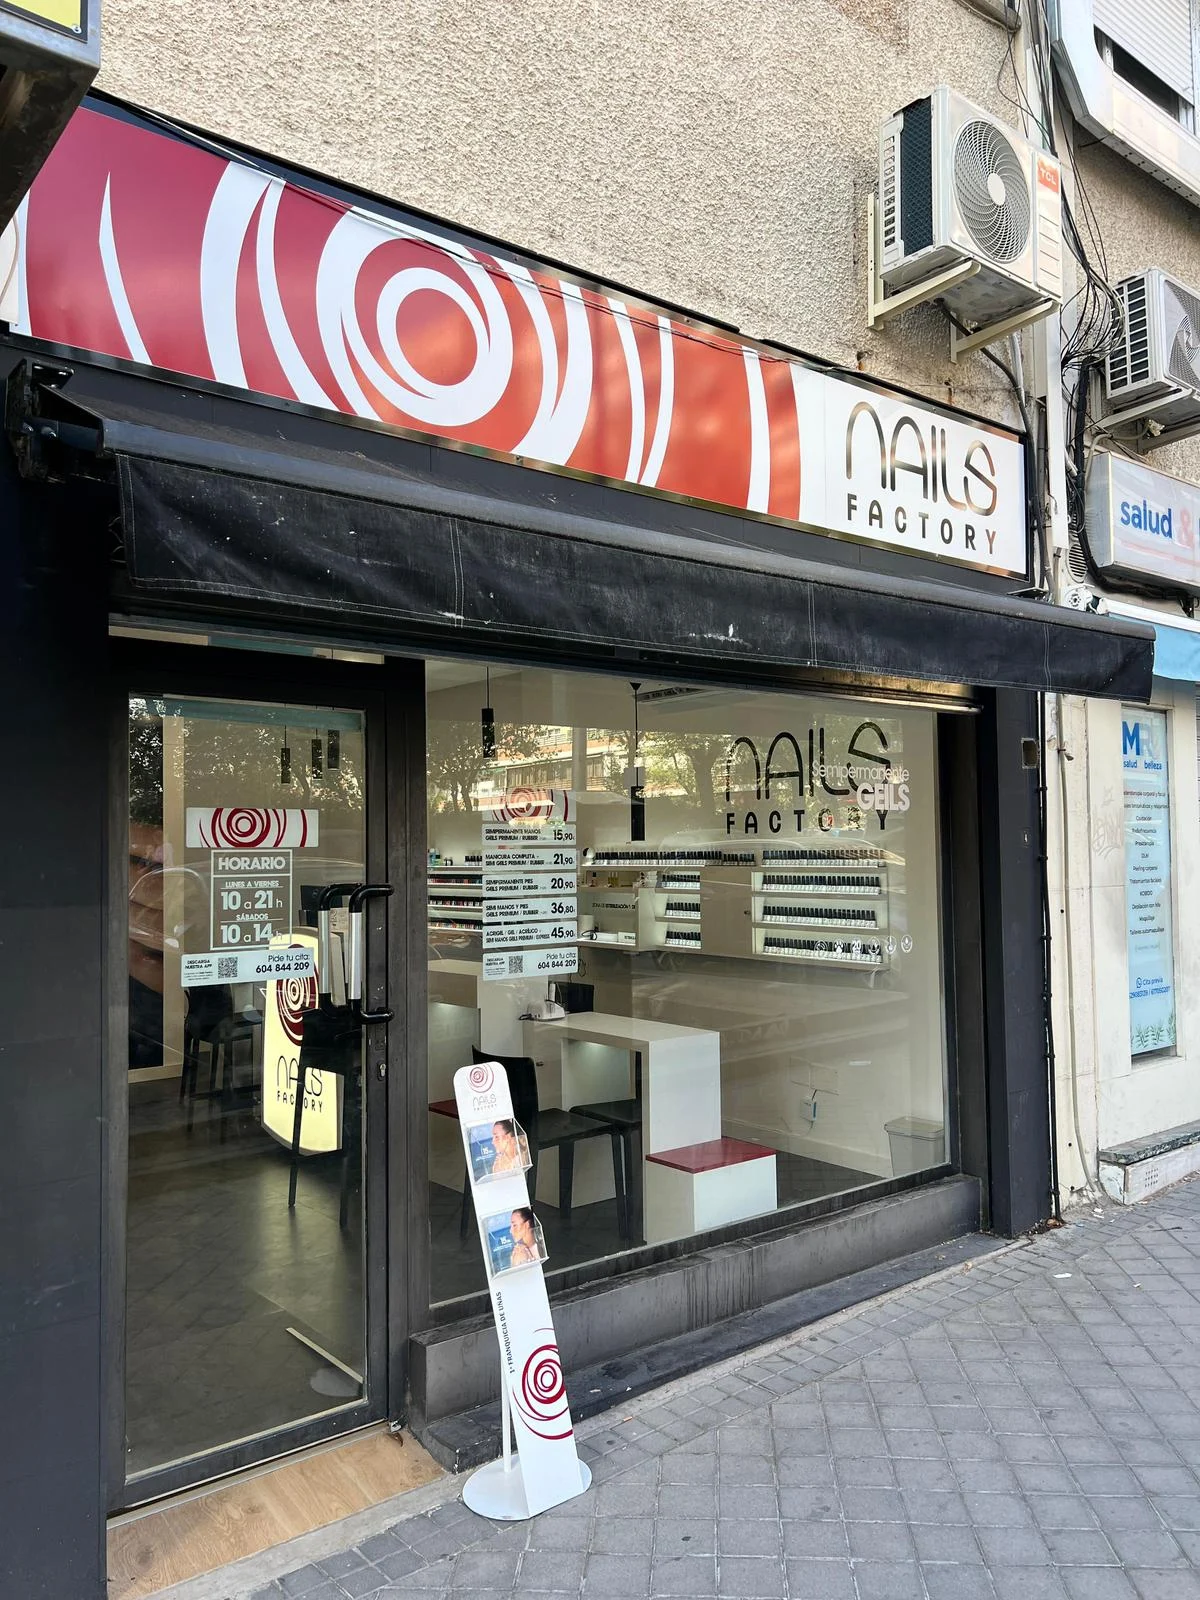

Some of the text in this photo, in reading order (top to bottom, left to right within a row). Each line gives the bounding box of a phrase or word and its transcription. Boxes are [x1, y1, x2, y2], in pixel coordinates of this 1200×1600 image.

[1040, 168, 1056, 186] TCL
[846, 400, 997, 516] NAILS
[846, 493, 997, 555] FACTORY
[1120, 500, 1172, 538] salud
[726, 722, 890, 802] NAILS
[812, 760, 910, 782] Semipermanente
[1123, 760, 1162, 770] salud belleza
[856, 782, 910, 811] GEILS
[726, 806, 889, 834] FACTORY
[218, 856, 286, 870] HORARIO
[221, 890, 283, 910] 10 a 21 h
[221, 924, 240, 944] 10
[253, 923, 273, 942] 14
[276, 930, 282, 941] h
[255, 962, 310, 973] 604 844 209
[268, 954, 285, 962] Pide
[277, 1090, 322, 1112] FACORY
[500, 1311, 506, 1321] DE
[501, 1322, 513, 1365] FRANQUICIA
